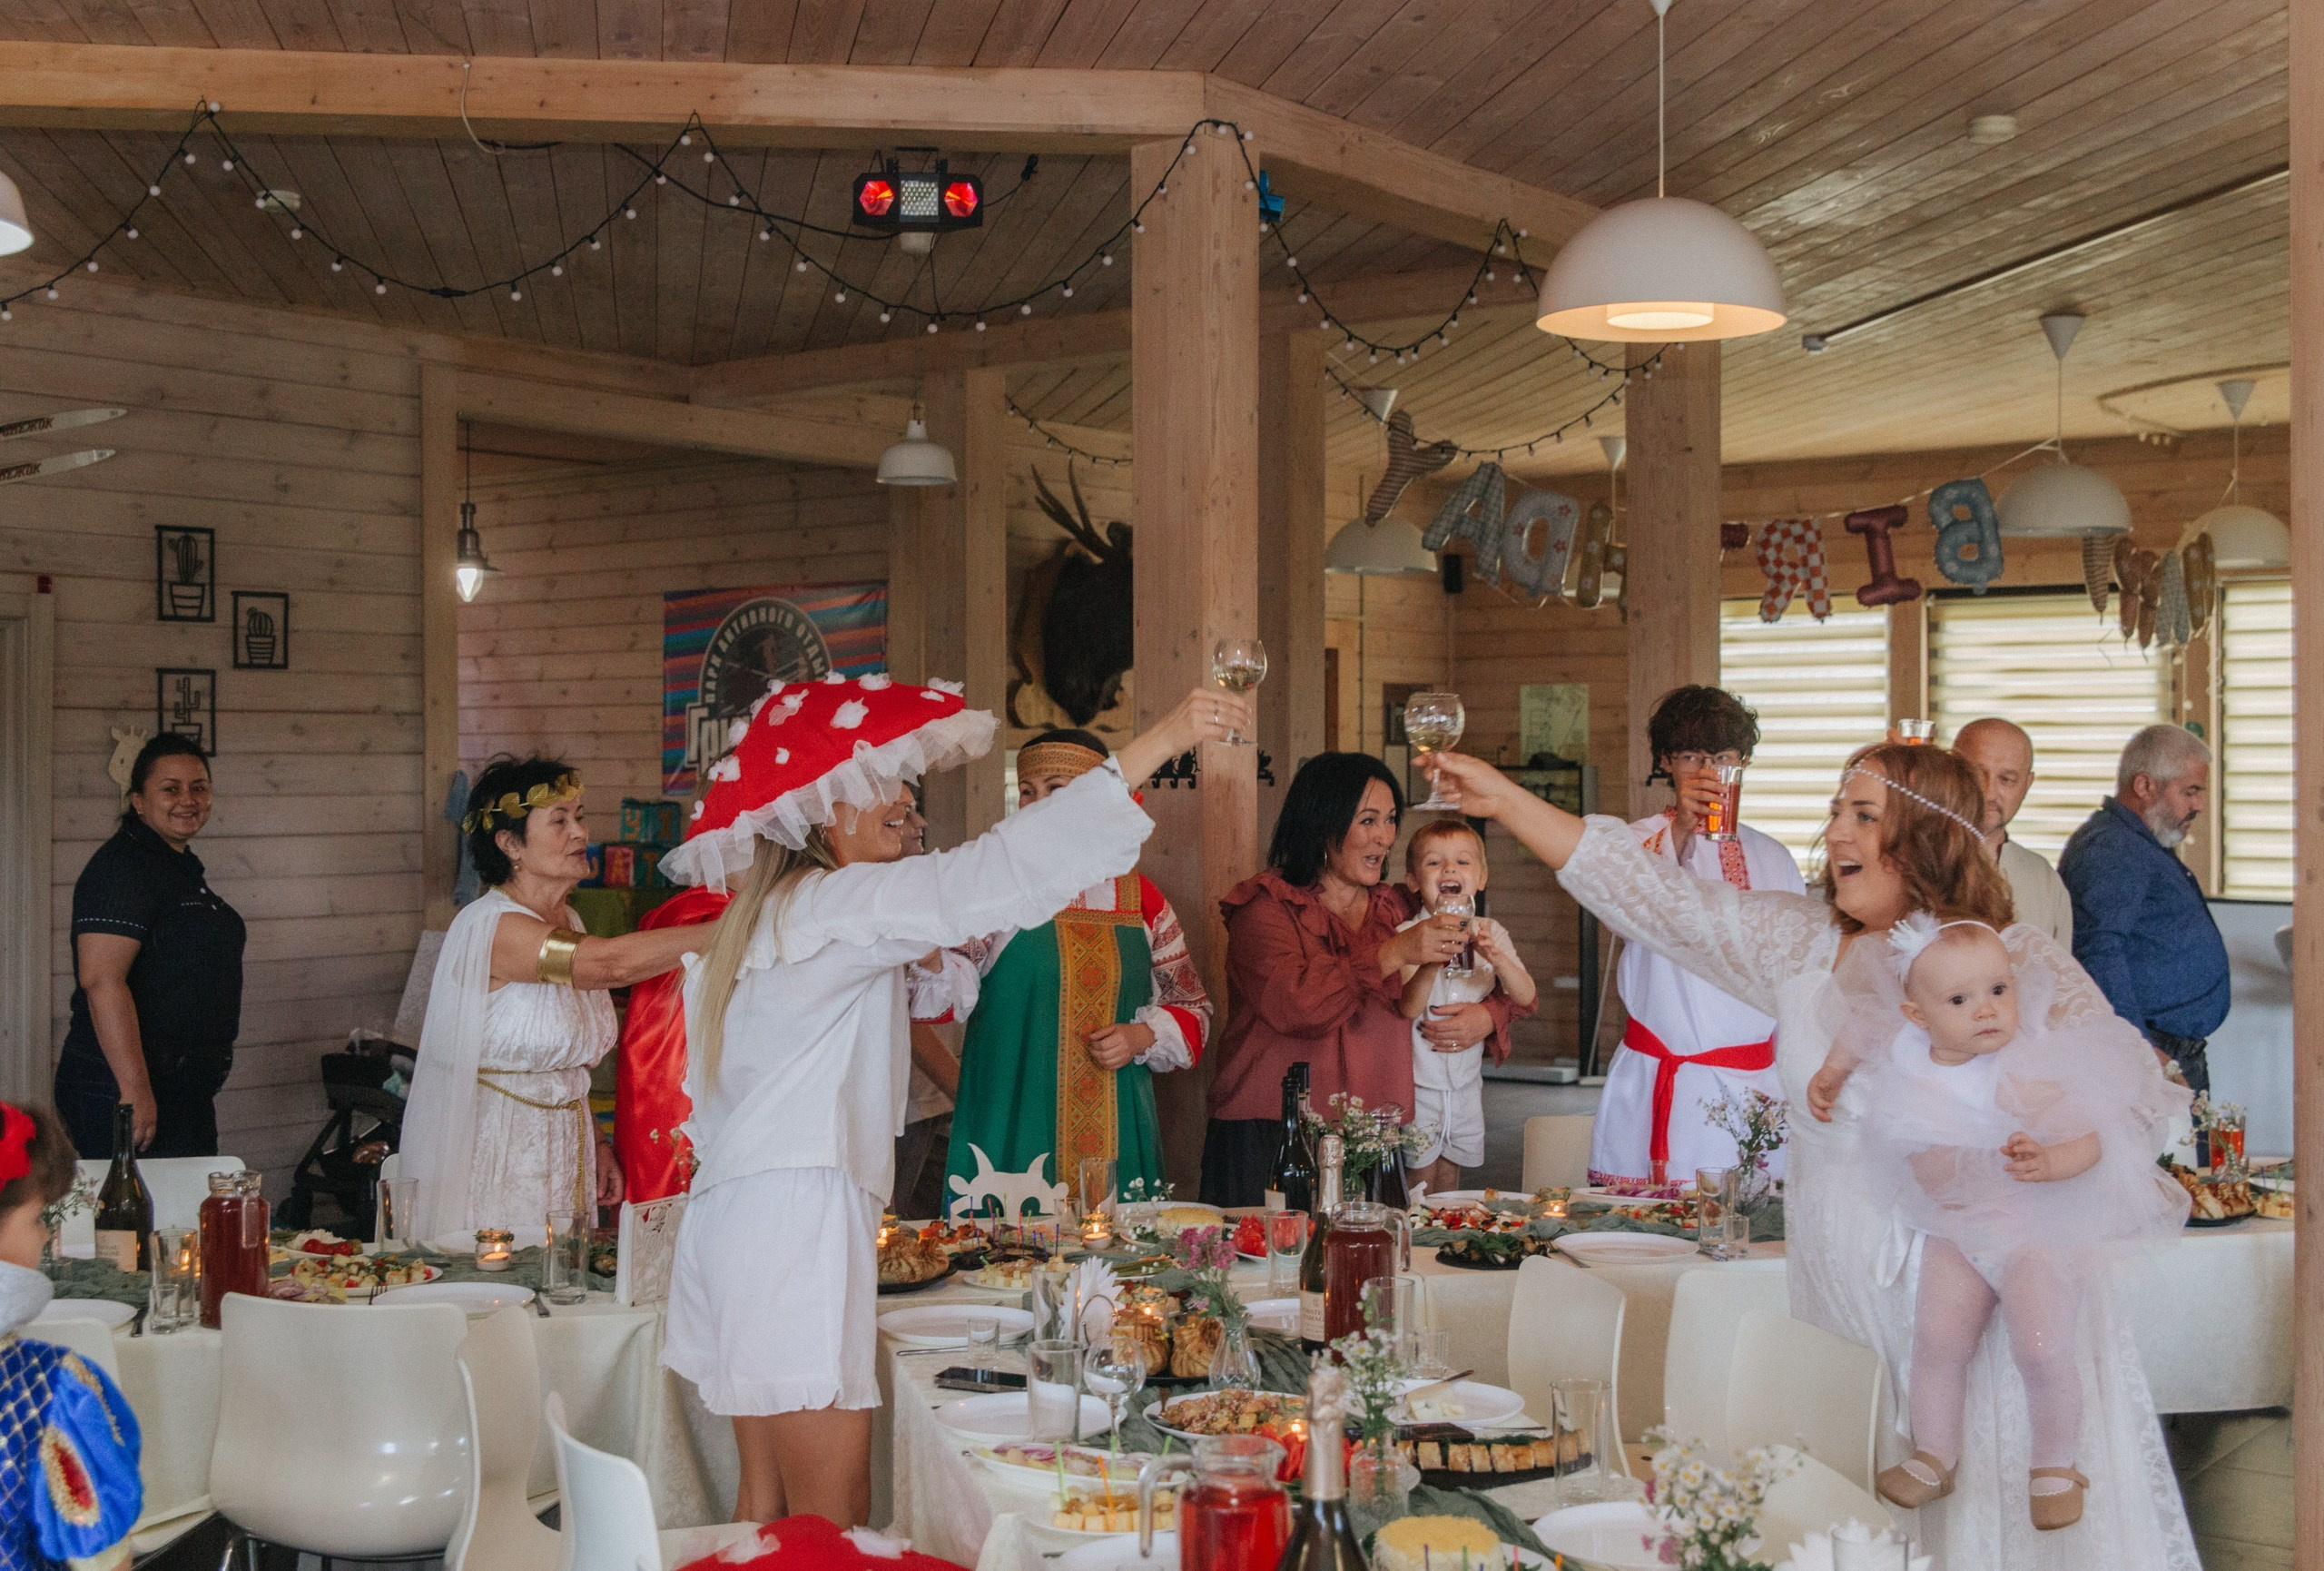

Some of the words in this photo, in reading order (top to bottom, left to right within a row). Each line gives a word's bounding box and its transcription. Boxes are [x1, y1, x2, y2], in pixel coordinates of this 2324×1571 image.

[704, 655, 723, 703] ПАРК
[717, 607, 795, 653] АКТИВНОГО
[795, 623, 827, 682] ОТДЫ
